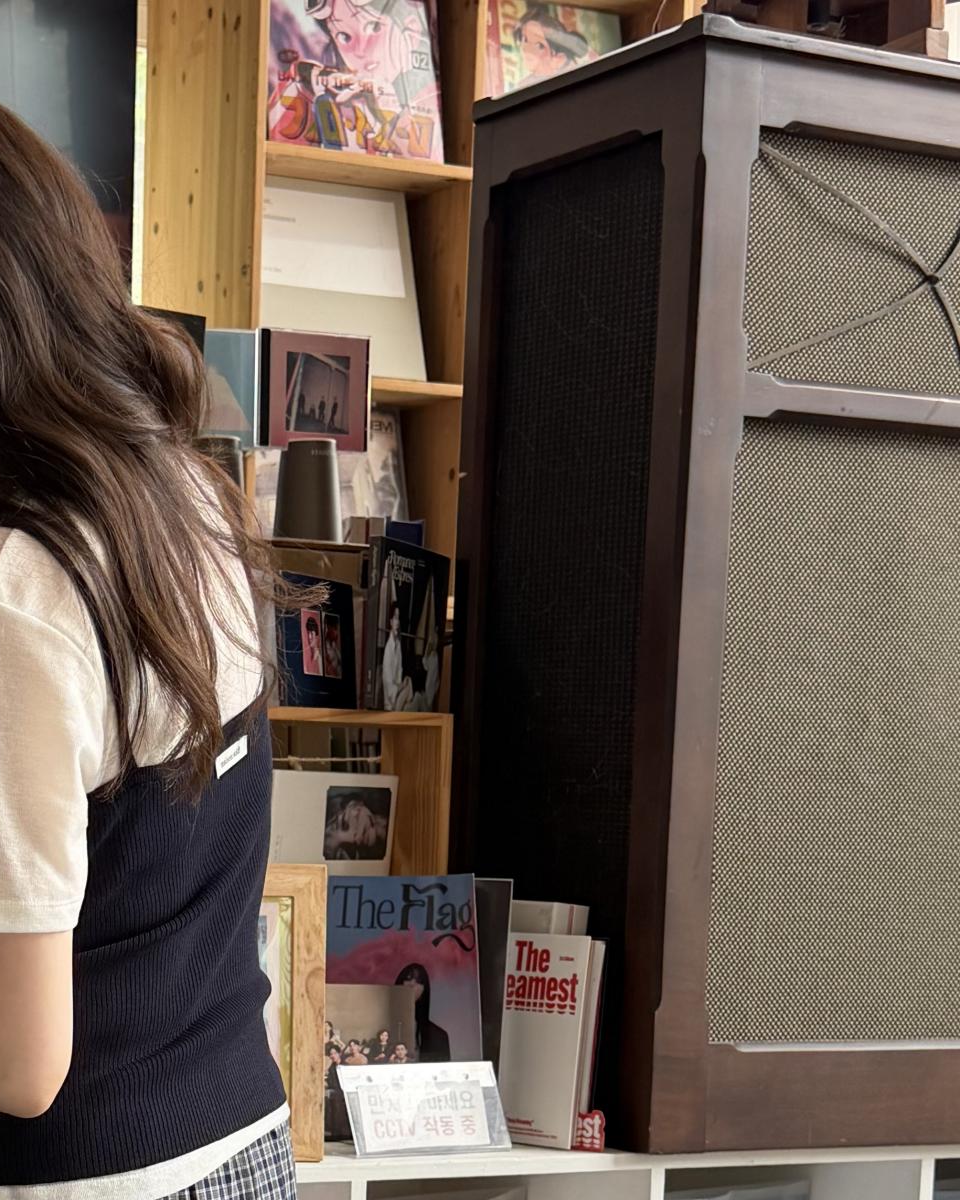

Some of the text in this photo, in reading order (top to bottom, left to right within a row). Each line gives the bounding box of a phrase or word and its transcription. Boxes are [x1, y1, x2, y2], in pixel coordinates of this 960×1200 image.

[333, 883, 476, 952] The Flag
[515, 940, 550, 973] The
[422, 1115, 455, 1136] 작동
[461, 1115, 476, 1136] 중
